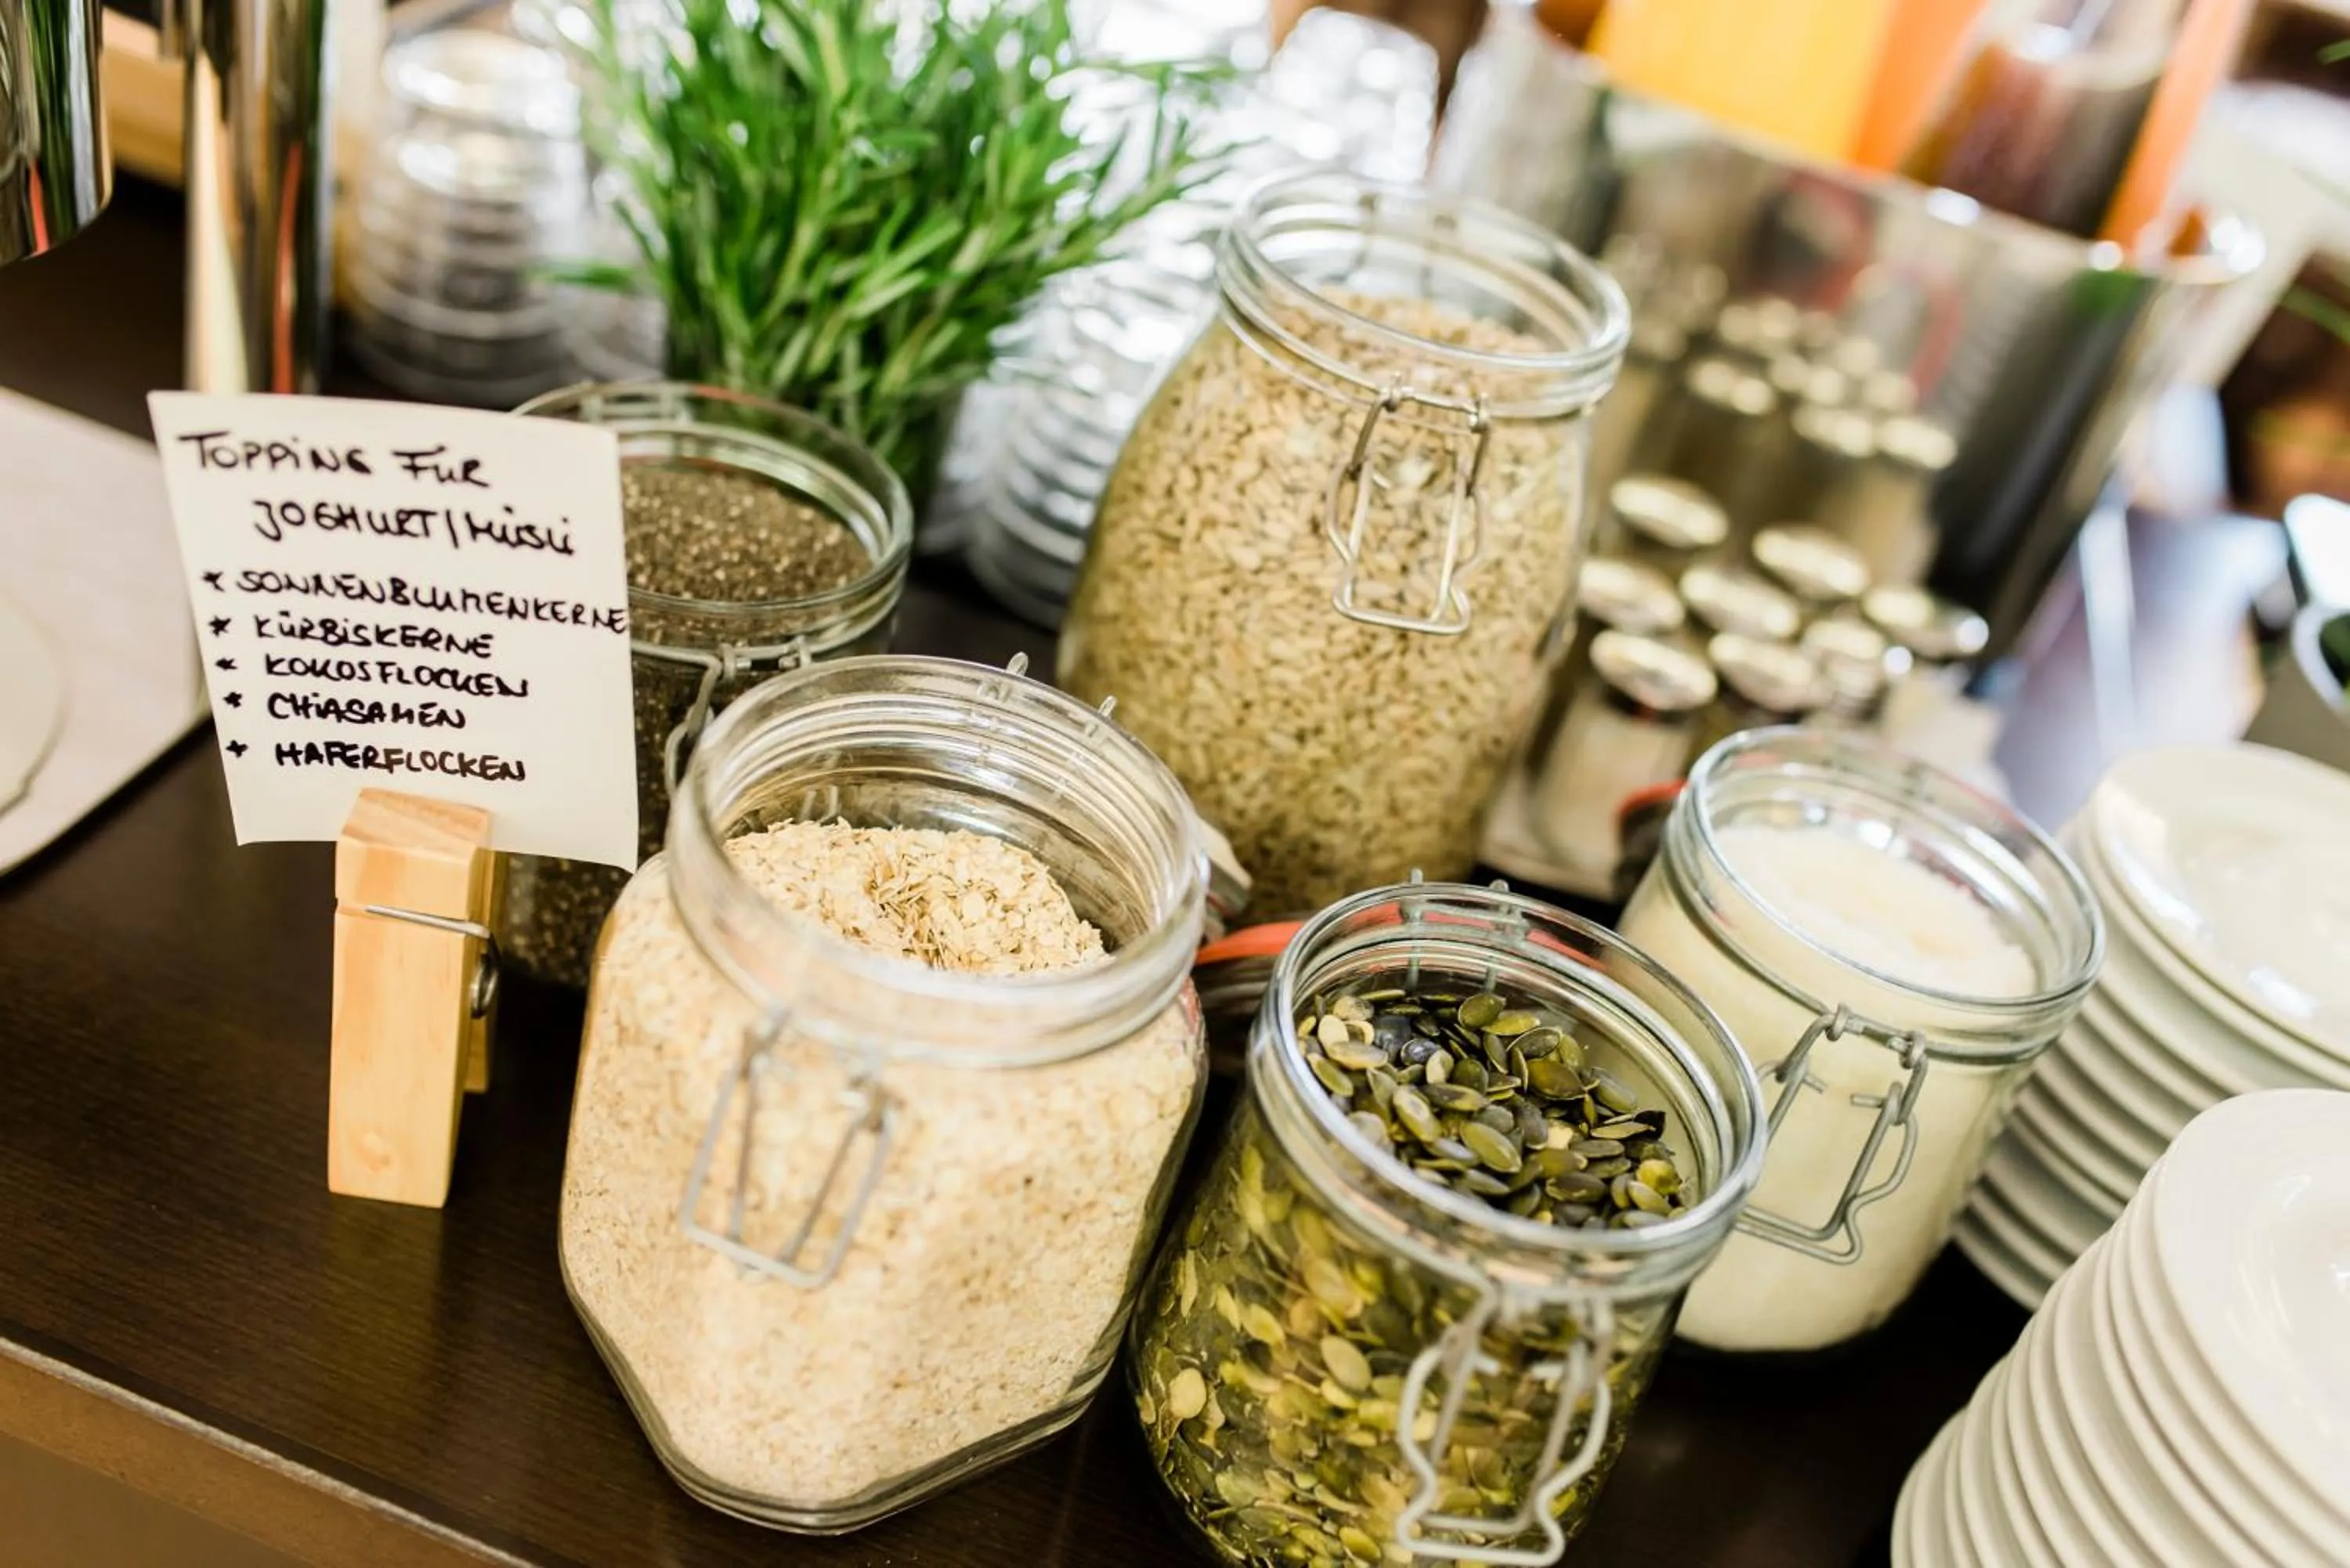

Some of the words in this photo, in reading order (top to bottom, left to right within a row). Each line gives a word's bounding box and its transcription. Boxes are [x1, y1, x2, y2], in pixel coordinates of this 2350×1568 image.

[237, 570, 627, 634] SONNENBLUMENKERNE
[265, 653, 529, 698] KOKOSFLOCKEN
[275, 740, 526, 781] HAFERFLOCKEN
